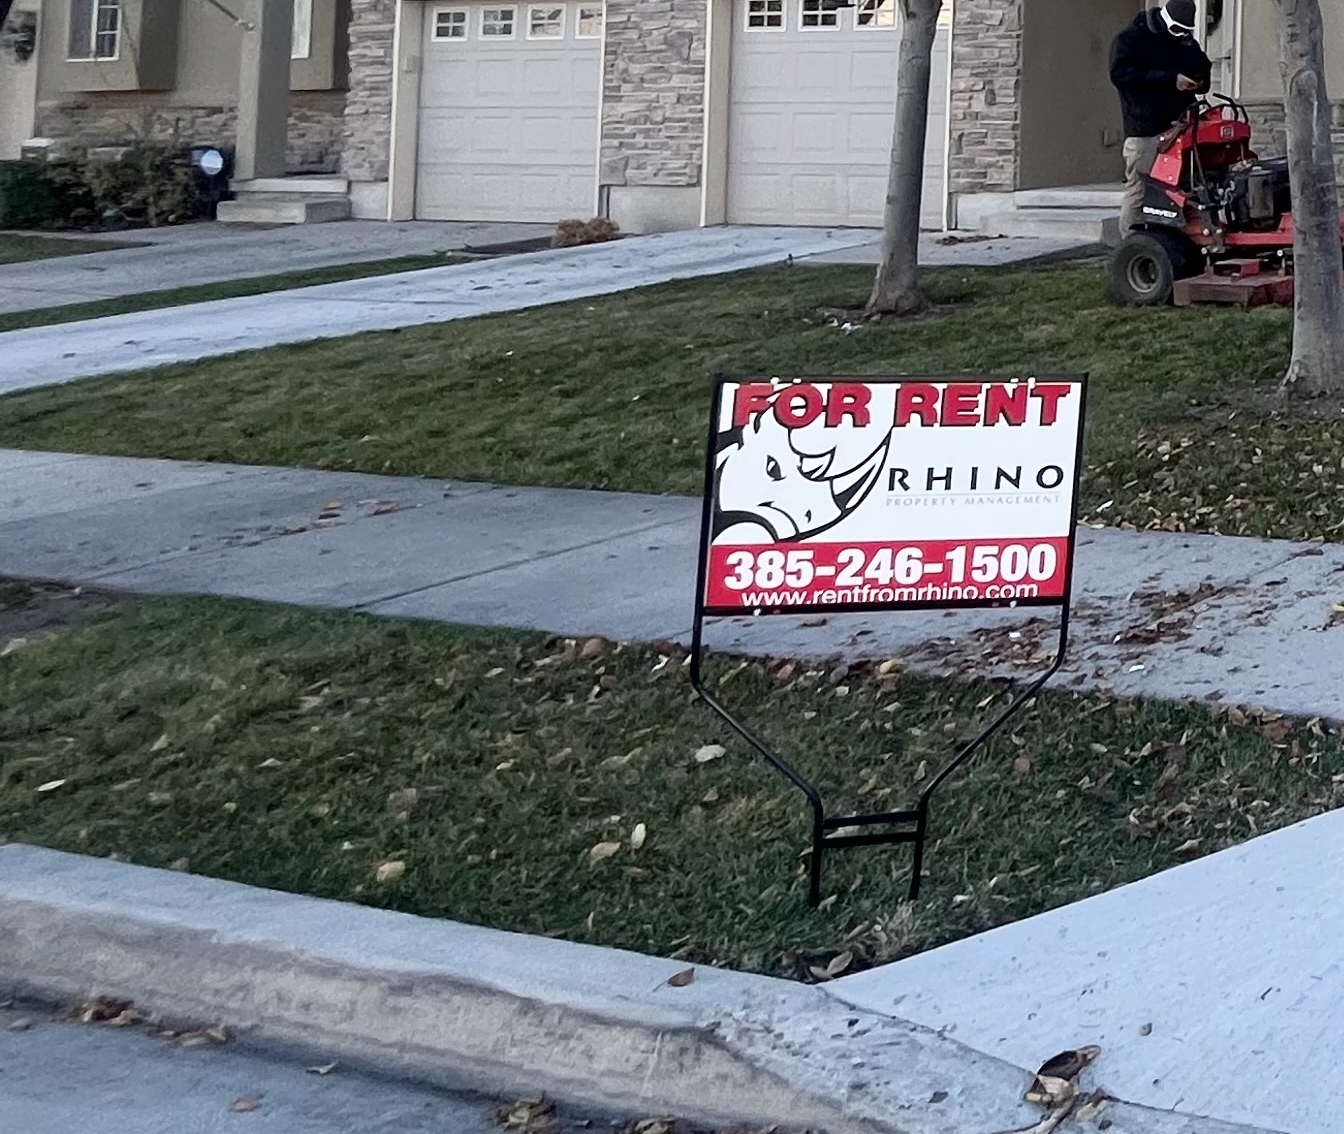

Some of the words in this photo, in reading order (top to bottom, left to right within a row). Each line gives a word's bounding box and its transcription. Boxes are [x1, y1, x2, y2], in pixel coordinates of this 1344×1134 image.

[732, 382, 876, 429] FOR
[894, 382, 1072, 427] RENT
[888, 465, 1064, 491] RHINO
[886, 496, 956, 507] PROPERTY
[964, 495, 1062, 506] MANAGEMENT
[723, 543, 1057, 590] 385-246-1500
[741, 581, 1039, 607] www.rentfromrhino.com
